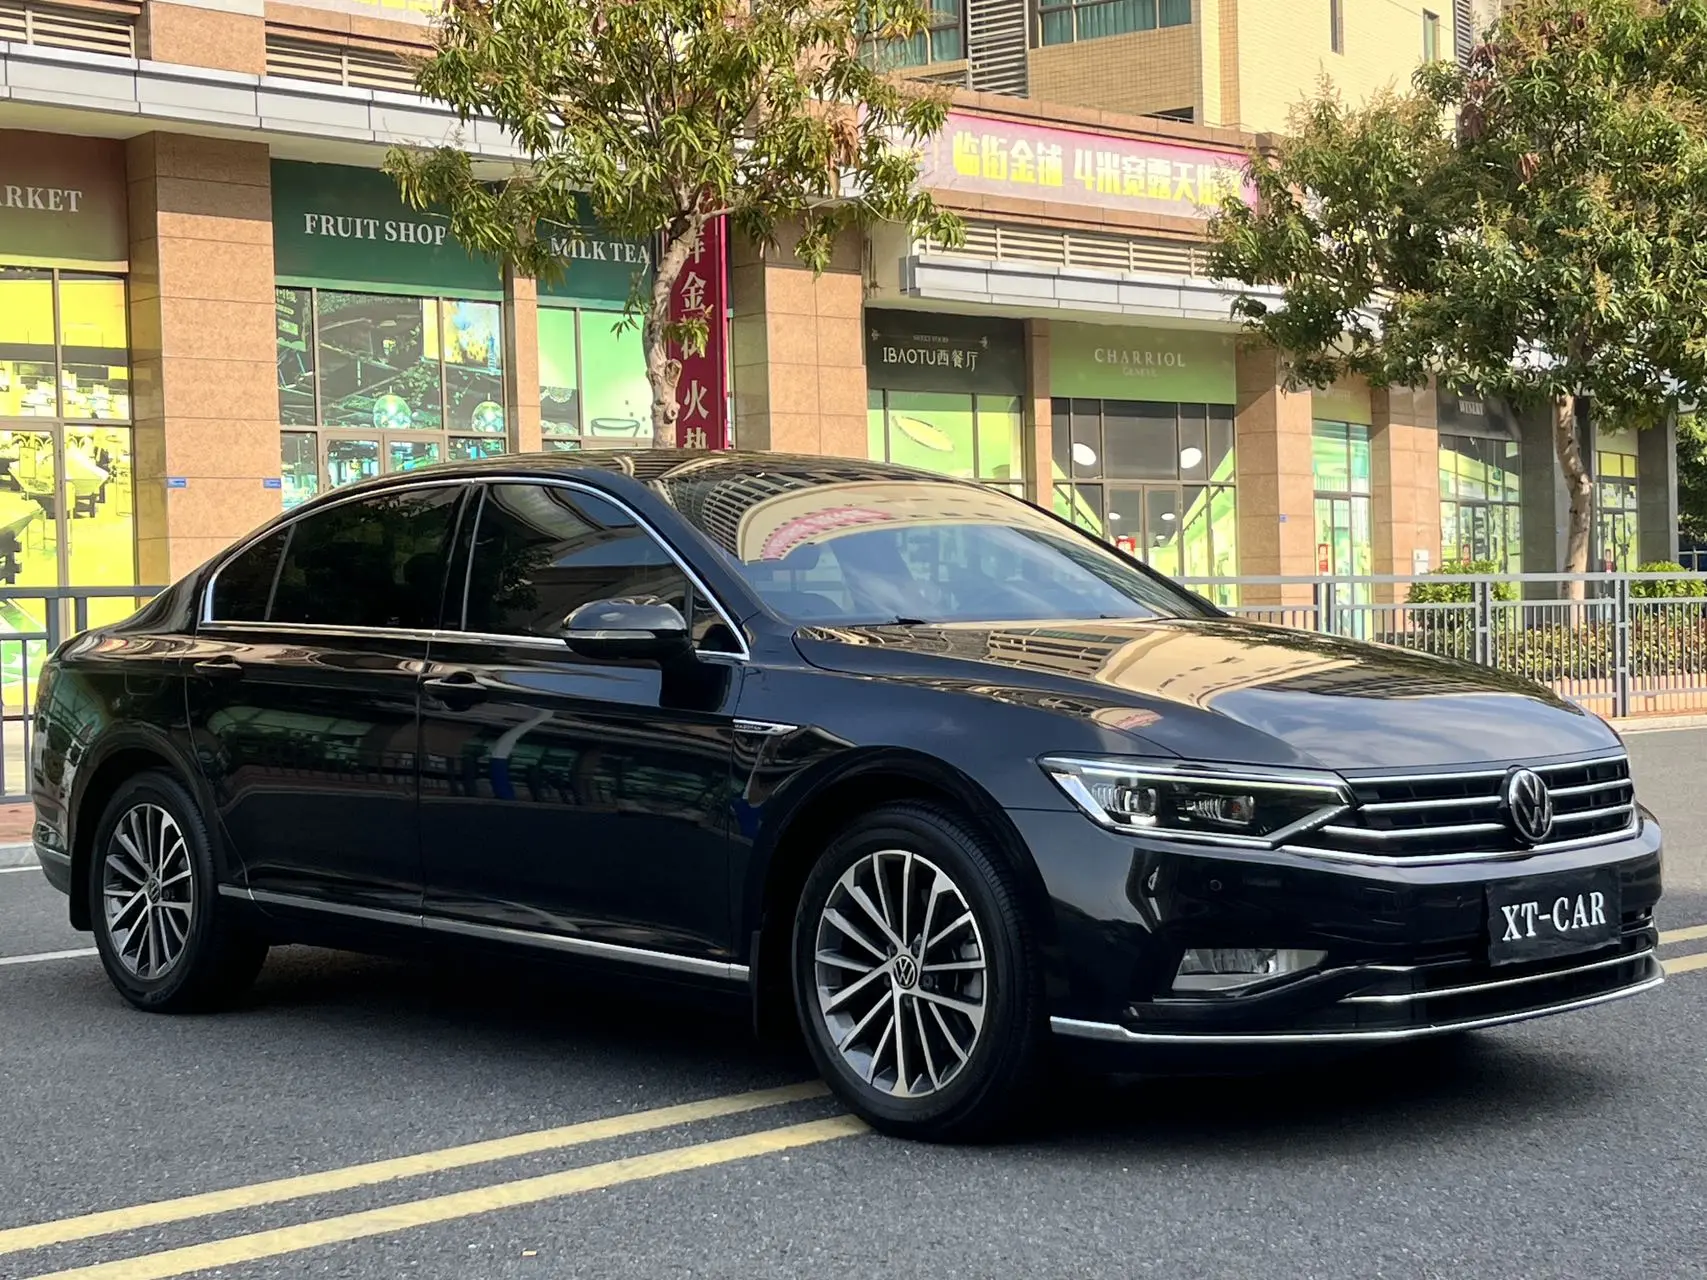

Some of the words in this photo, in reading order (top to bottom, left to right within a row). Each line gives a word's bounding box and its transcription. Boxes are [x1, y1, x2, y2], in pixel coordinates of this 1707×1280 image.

[953, 131, 1064, 187] 临街金铺
[0, 184, 83, 213] RKET
[304, 213, 379, 240] FRUIT
[384, 220, 447, 246] SHOP
[550, 237, 606, 261] MILK
[609, 242, 651, 265] TEA
[1094, 348, 1186, 368] CHARRIOL
[1501, 891, 1607, 942] XT-CAR
